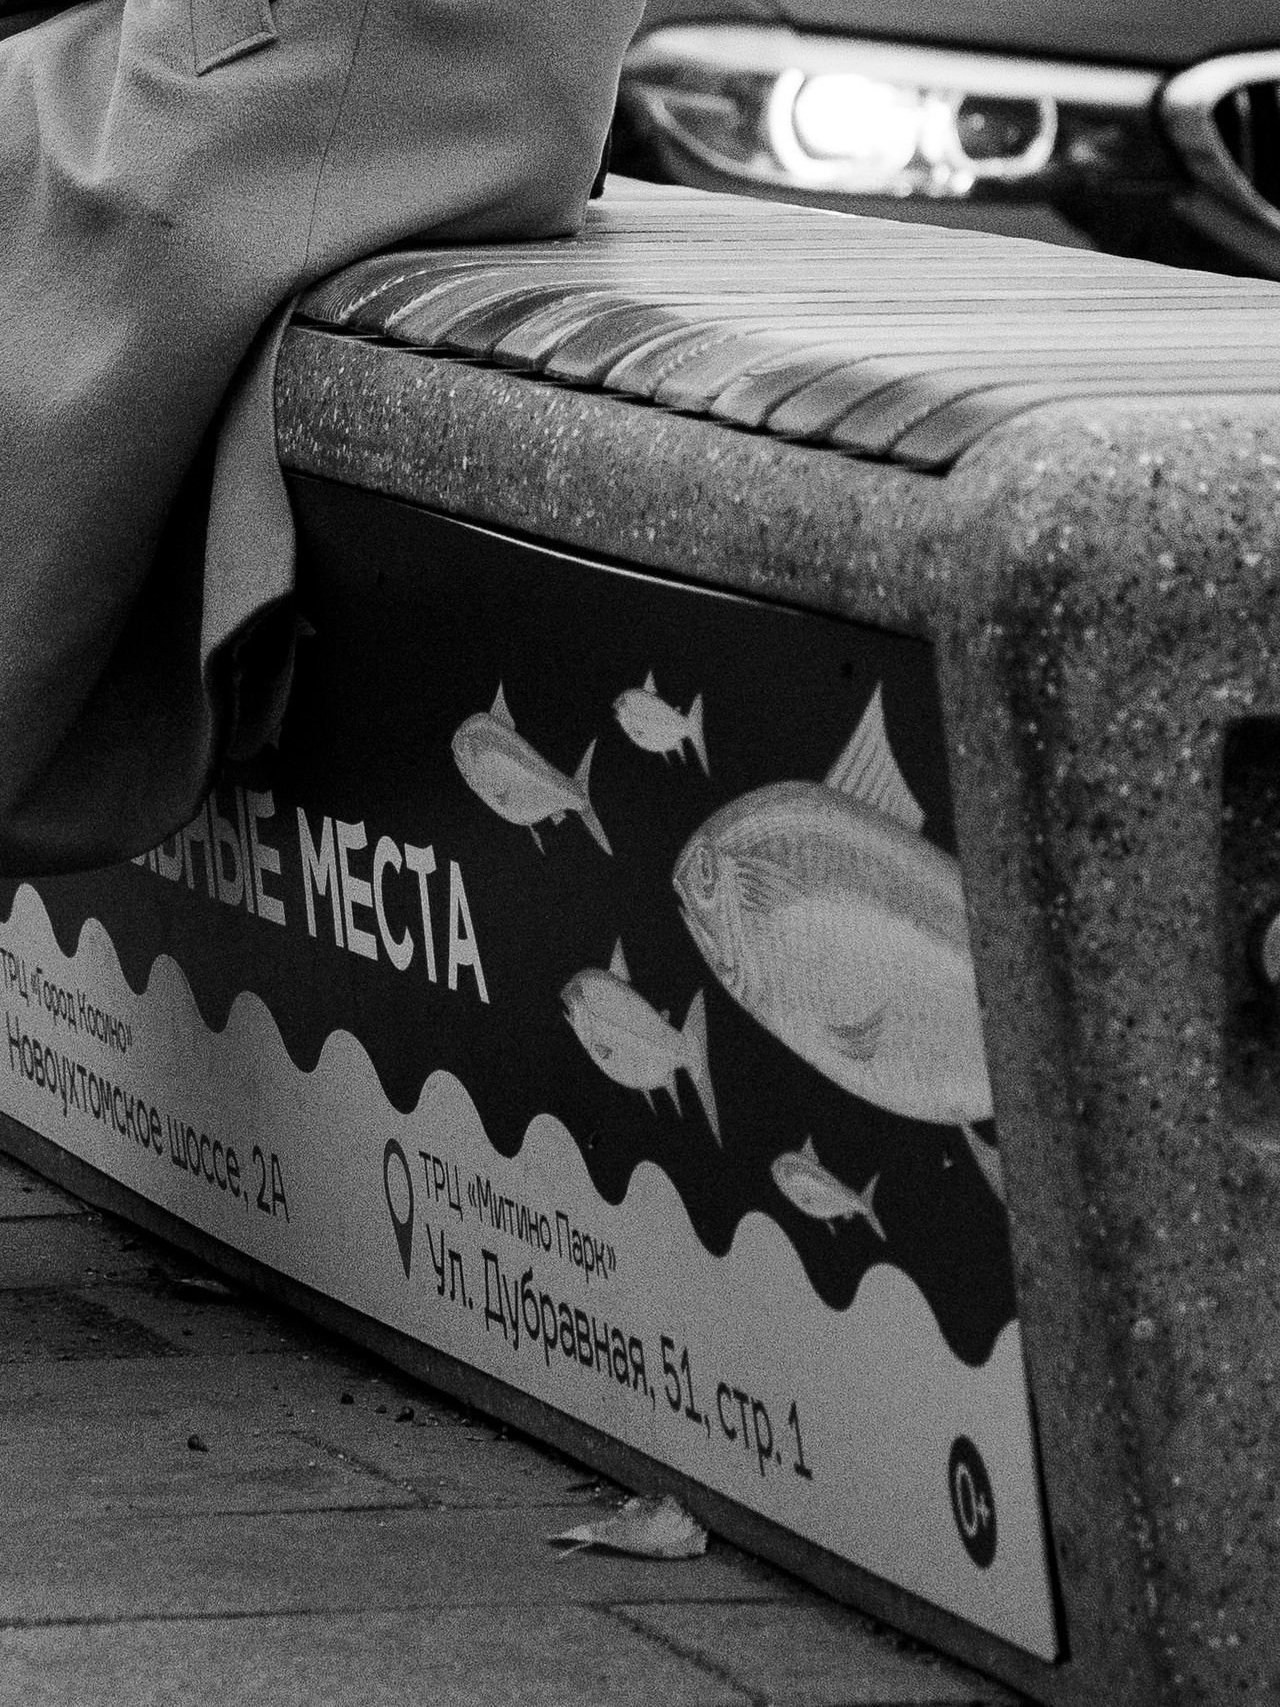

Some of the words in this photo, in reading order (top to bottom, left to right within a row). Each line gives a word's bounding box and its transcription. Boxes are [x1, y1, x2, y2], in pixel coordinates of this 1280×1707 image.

[296, 806, 491, 1005] МЕСТА
[0, 947, 29, 1007] ТРЦ
[31, 965, 78, 1035] «Город
[5, 1010, 163, 1157] Новоухтомское
[166, 1113, 249, 1215] шоссе,
[252, 1144, 290, 1224] 2А
[419, 1150, 463, 1222] ТРЦ
[468, 1173, 552, 1252] «Митино
[555, 1209, 616, 1284] Парк»
[426, 1222, 474, 1311] Ул.
[481, 1248, 657, 1411] Дубравная,
[659, 1334, 711, 1439] 51,
[717, 1380, 783, 1478] стр.
[788, 1399, 813, 1481] 1
[955, 1462, 991, 1538] 0+
